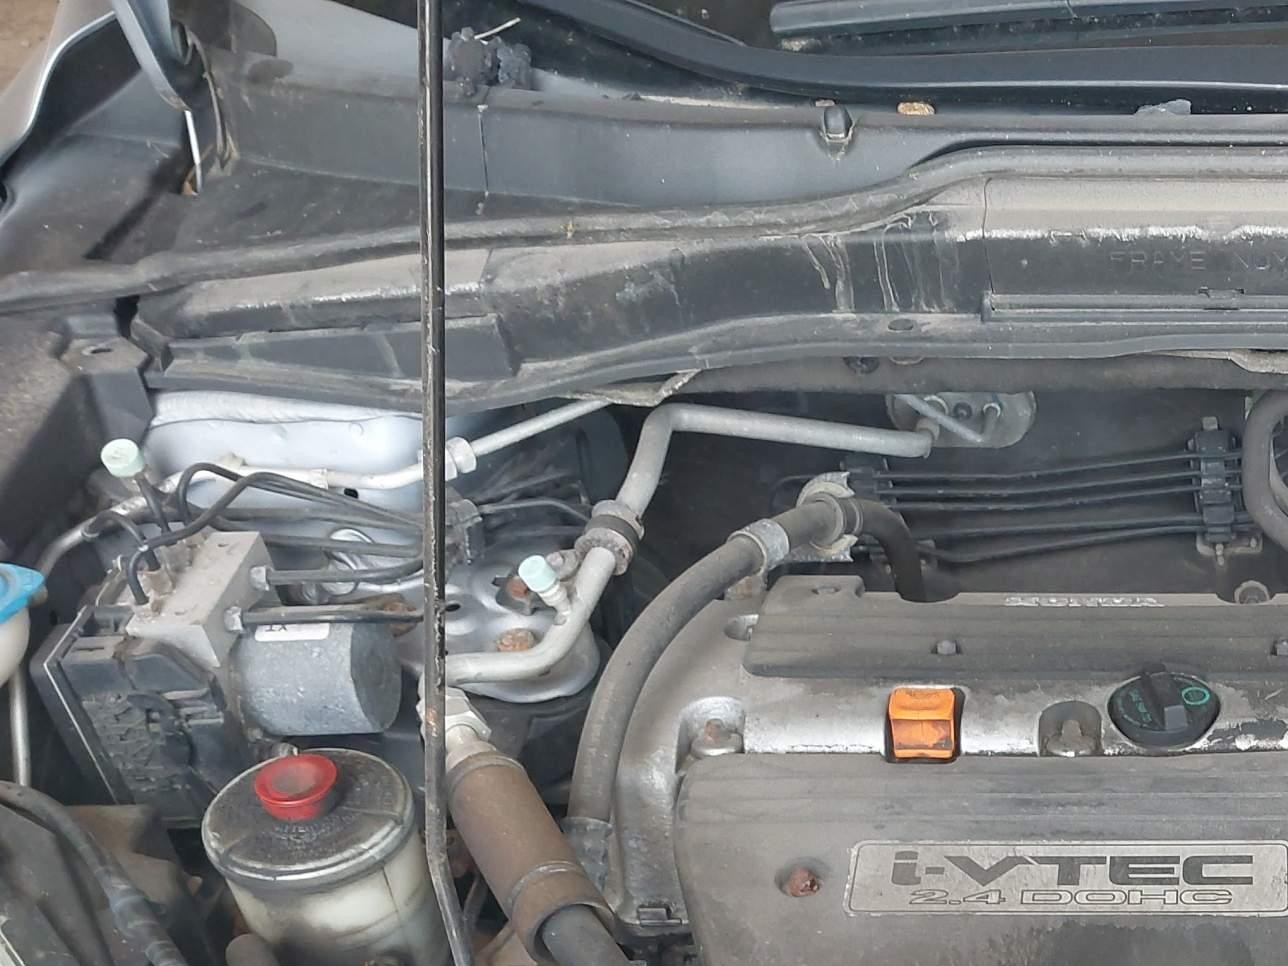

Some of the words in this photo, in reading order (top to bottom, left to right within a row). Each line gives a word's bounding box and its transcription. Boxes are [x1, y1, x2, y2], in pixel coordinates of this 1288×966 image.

[1110, 251, 1206, 271] FRAME
[892, 850, 1254, 886] i-VTEC
[909, 888, 1006, 905] 2.4
[1020, 888, 1233, 906] DOHC
